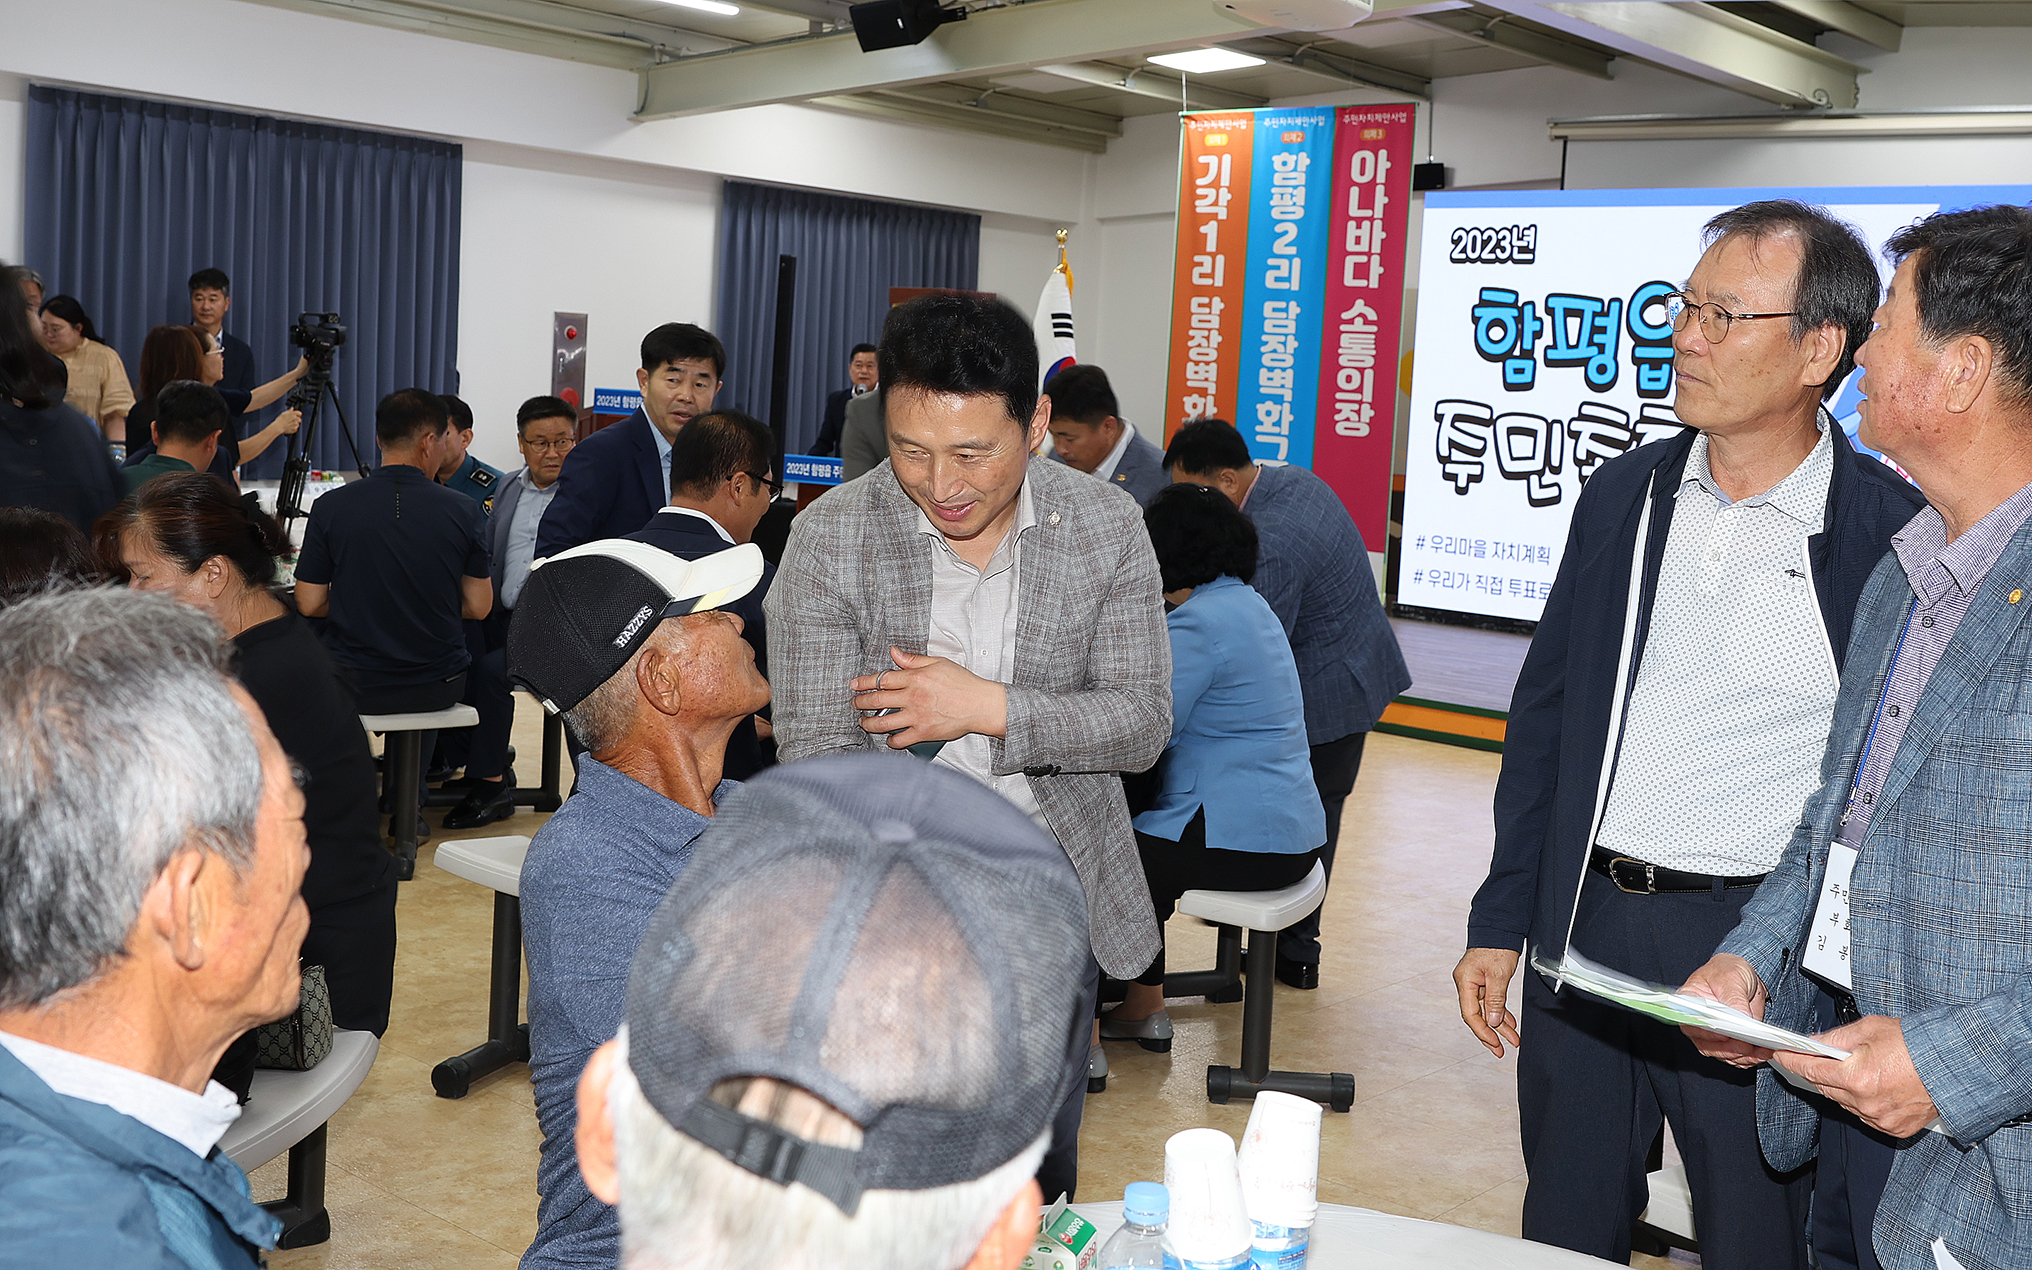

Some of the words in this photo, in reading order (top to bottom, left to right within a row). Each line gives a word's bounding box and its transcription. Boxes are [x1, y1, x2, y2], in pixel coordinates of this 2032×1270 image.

[1263, 116, 1326, 128] 주민자치제안사업
[1343, 112, 1407, 125] 주민자치제안사업
[1192, 153, 1232, 287] 기각1리
[1265, 151, 1311, 291] 함평2리
[1342, 149, 1392, 289] 아나바다
[1449, 224, 1537, 264] 2023년
[1182, 296, 1225, 423] 담장벽화
[1472, 281, 1677, 398] 함평읍
[1333, 298, 1378, 437] 소통의장
[596, 395, 621, 408] 2023년
[786, 462, 810, 476] 2023년
[811, 463, 832, 478] 함평읍
[1430, 535, 1487, 559] 우리마을
[1491, 541, 1551, 565] 자치계획
[1428, 569, 1471, 591] 우리가
[1475, 574, 1504, 596] 직접
[1508, 578, 1552, 600] 투표로
[616, 605, 653, 648] HAZZYS
